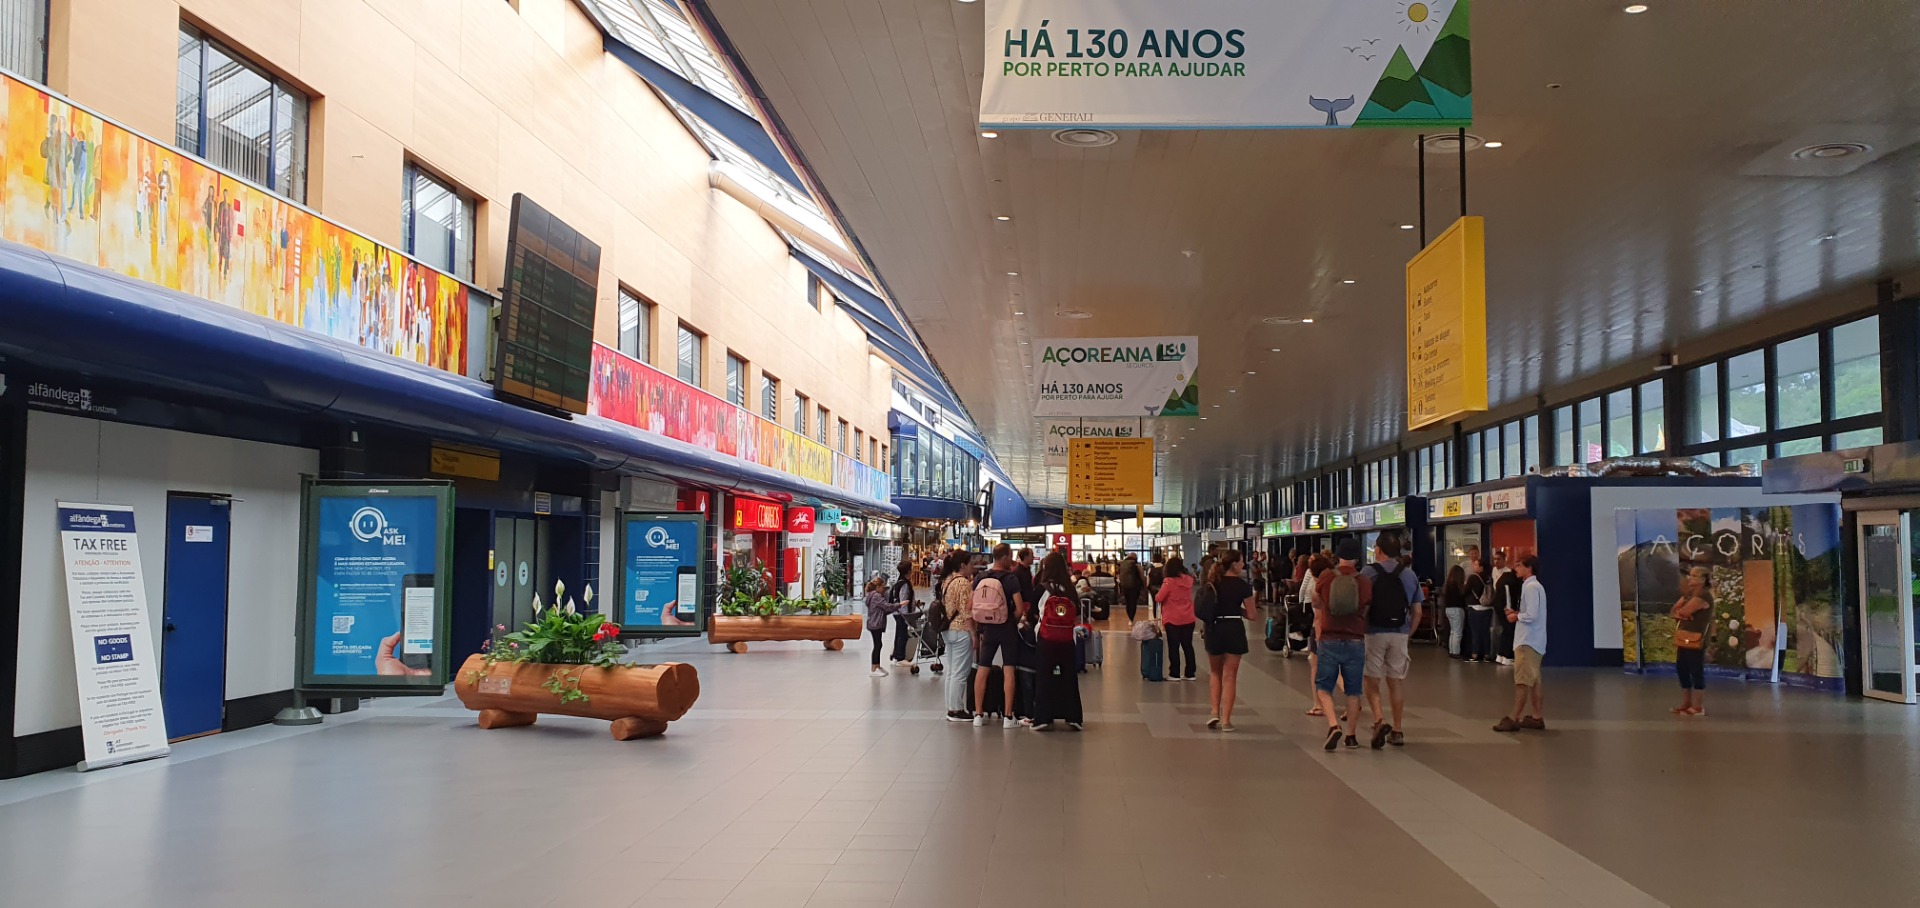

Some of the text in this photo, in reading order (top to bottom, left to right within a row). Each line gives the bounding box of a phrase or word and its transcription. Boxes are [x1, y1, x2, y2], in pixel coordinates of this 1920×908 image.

[1004, 19, 1246, 58] HÁ 130 ANOS
[1003, 61, 1246, 77] POR PERTO PARA AJUDAR
[1040, 112, 1093, 122] GENERALI
[1042, 346, 1153, 367] AÇOREANA
[28, 382, 80, 405] alfândega
[1041, 381, 1123, 394] HÁ 130 ANOS
[92, 405, 118, 415] customs
[1310, 514, 1320, 526] E
[383, 527, 399, 535] ASK
[73, 538, 128, 551] TAX FREE
[383, 535, 406, 546] ME!
[109, 637, 128, 645] GOODS
